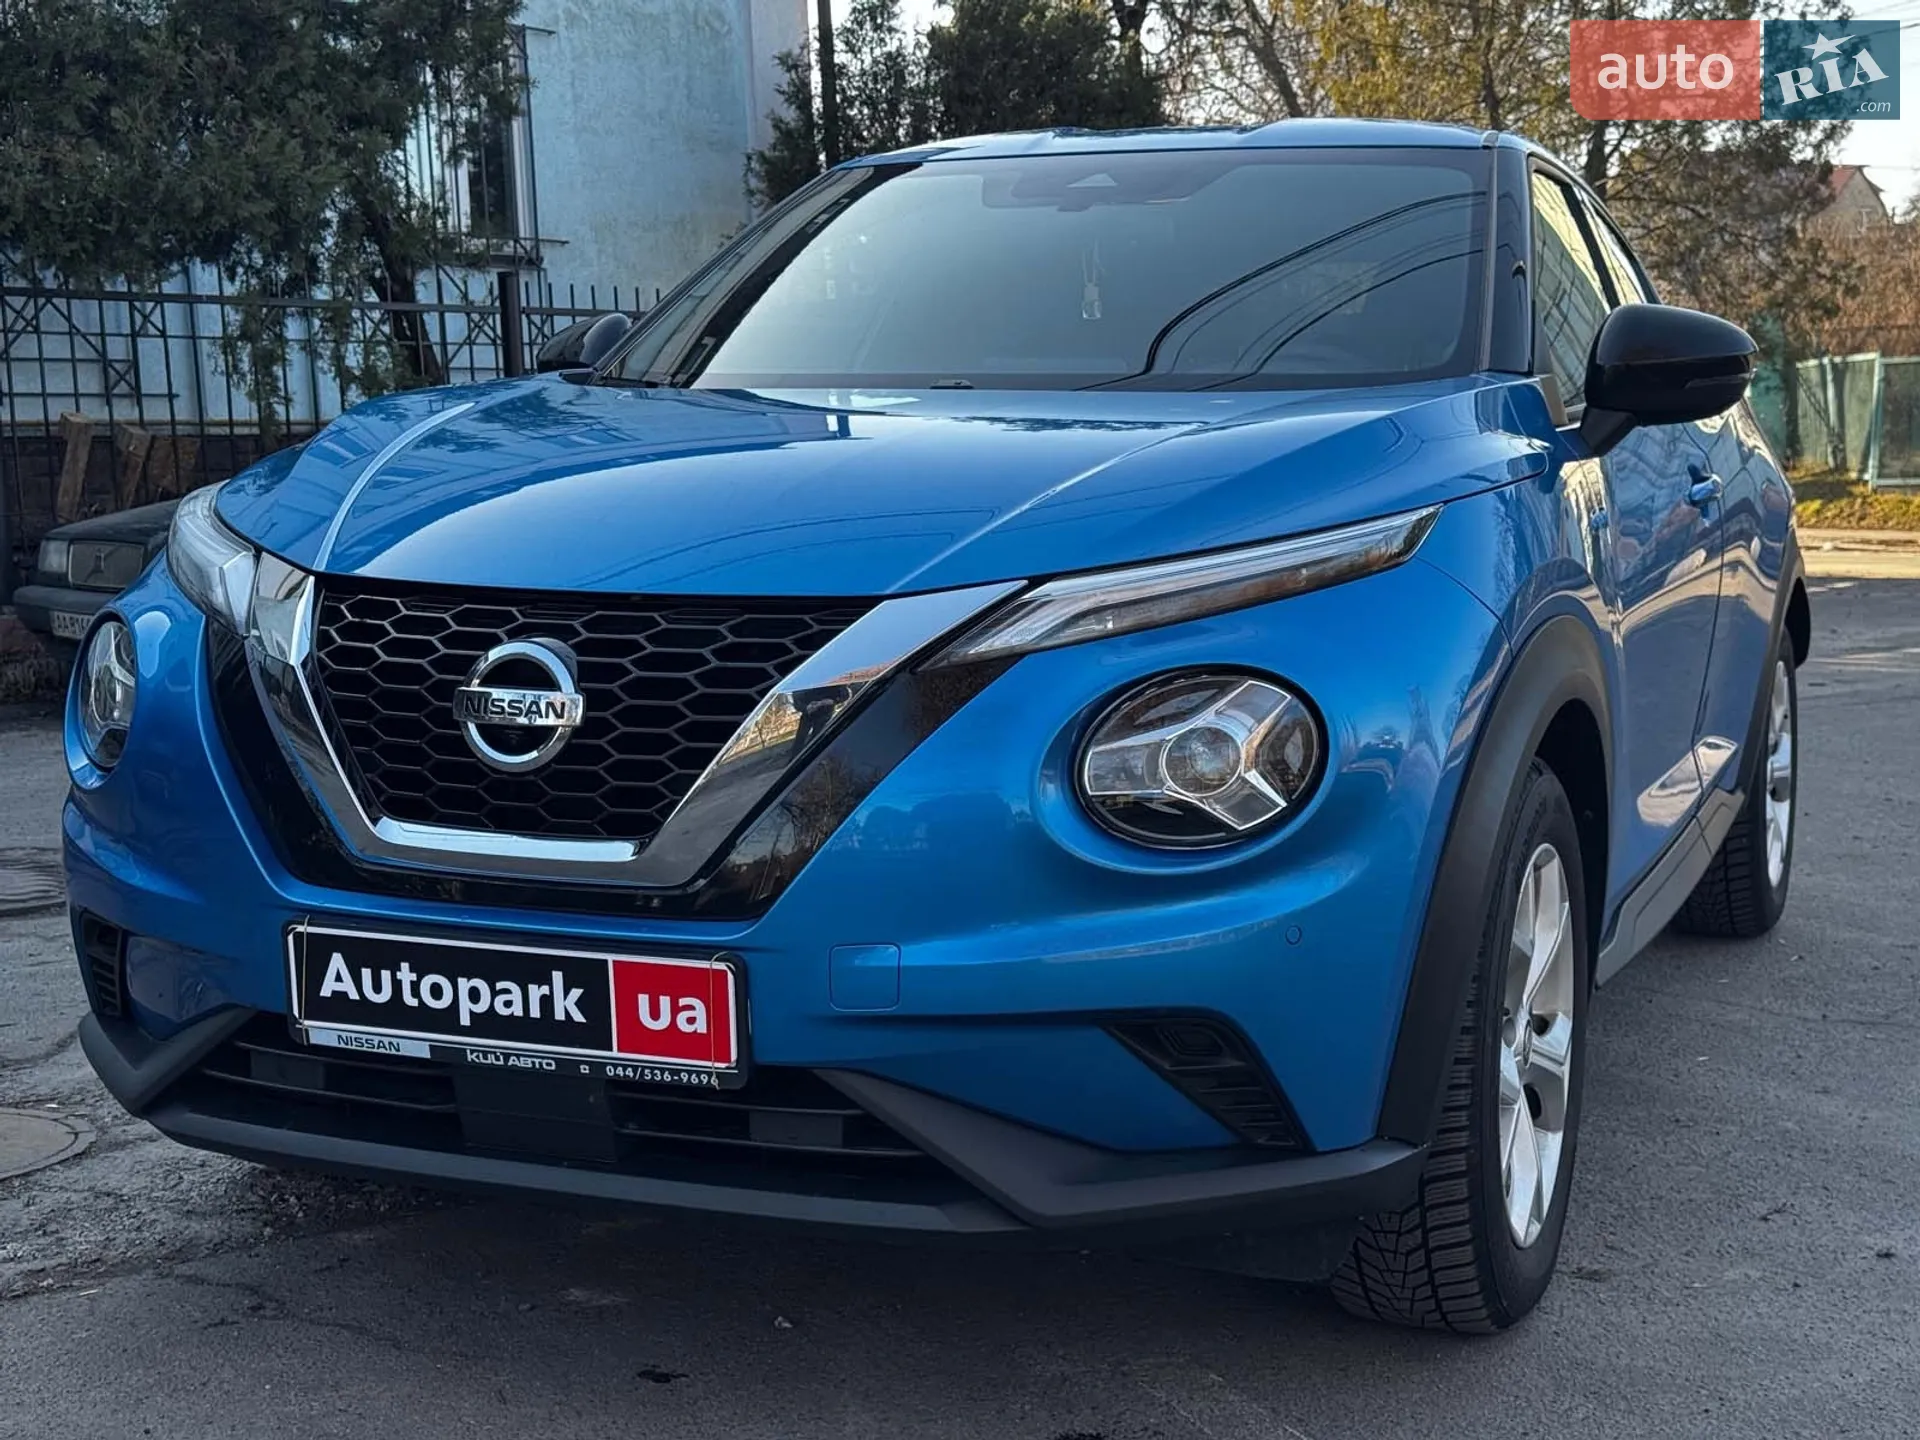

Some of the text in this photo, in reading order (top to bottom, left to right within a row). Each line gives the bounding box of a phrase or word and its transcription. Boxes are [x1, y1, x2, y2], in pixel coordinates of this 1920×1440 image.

[463, 690, 566, 720] NISSAN
[319, 951, 708, 1035] Autopark ua
[336, 1034, 401, 1053] NISSAN
